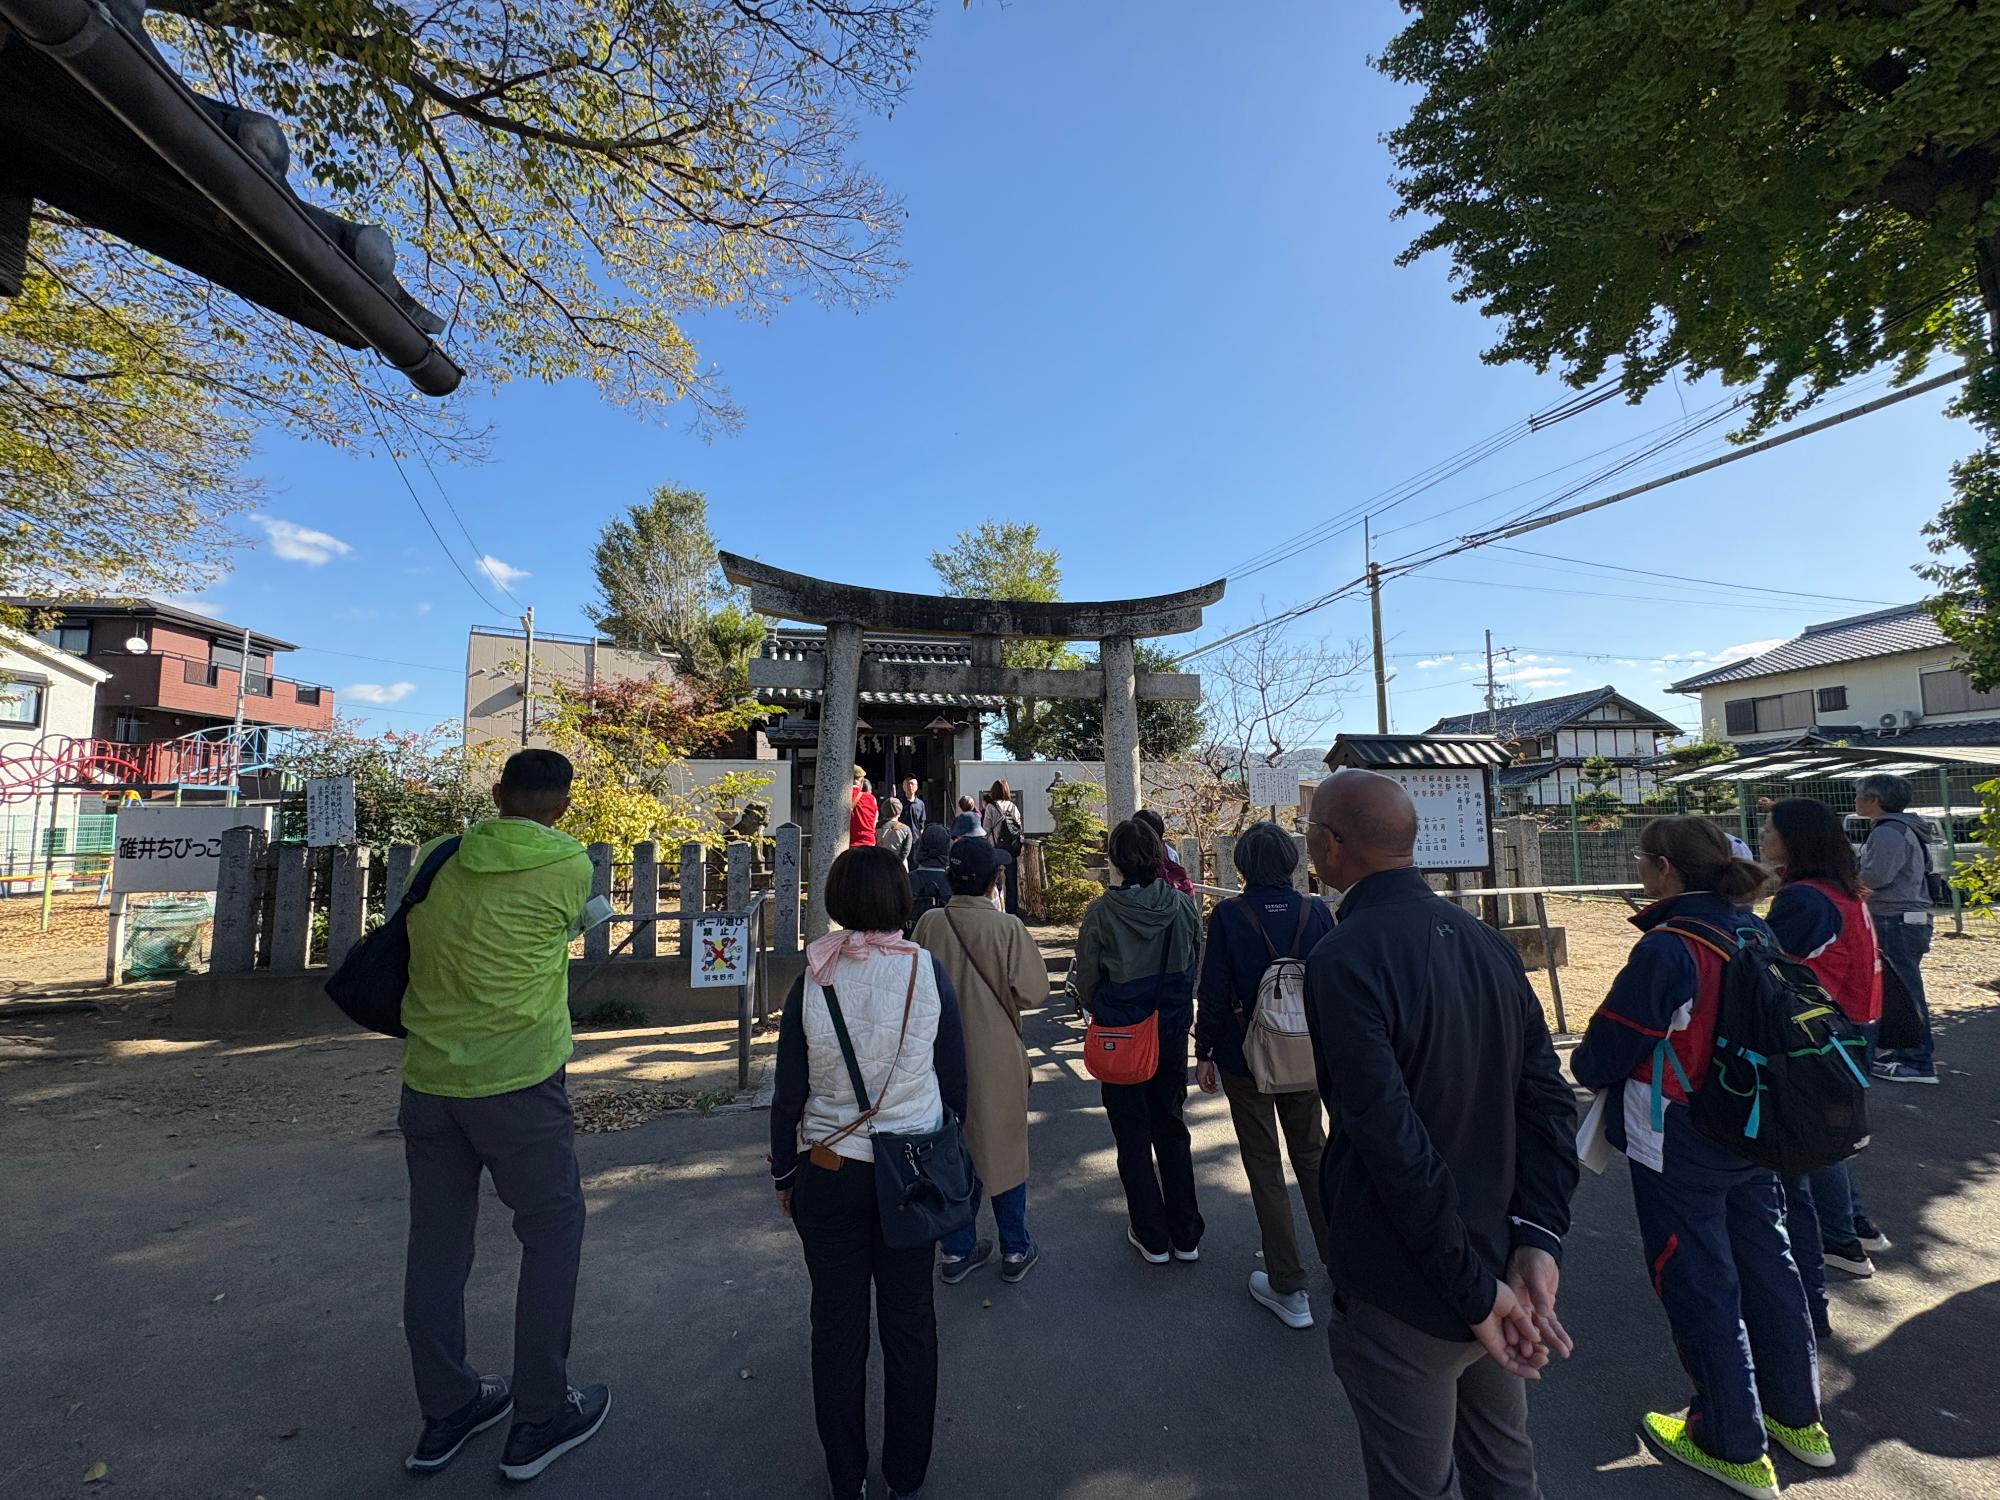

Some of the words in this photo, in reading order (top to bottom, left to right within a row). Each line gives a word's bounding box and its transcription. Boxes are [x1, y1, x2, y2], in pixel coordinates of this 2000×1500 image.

[119, 837, 222, 860] 碓井ちびっこ
[779, 851, 796, 922] 氏子中
[696, 917, 745, 927] ボール遊び
[704, 974, 734, 982] 羽曳野市
